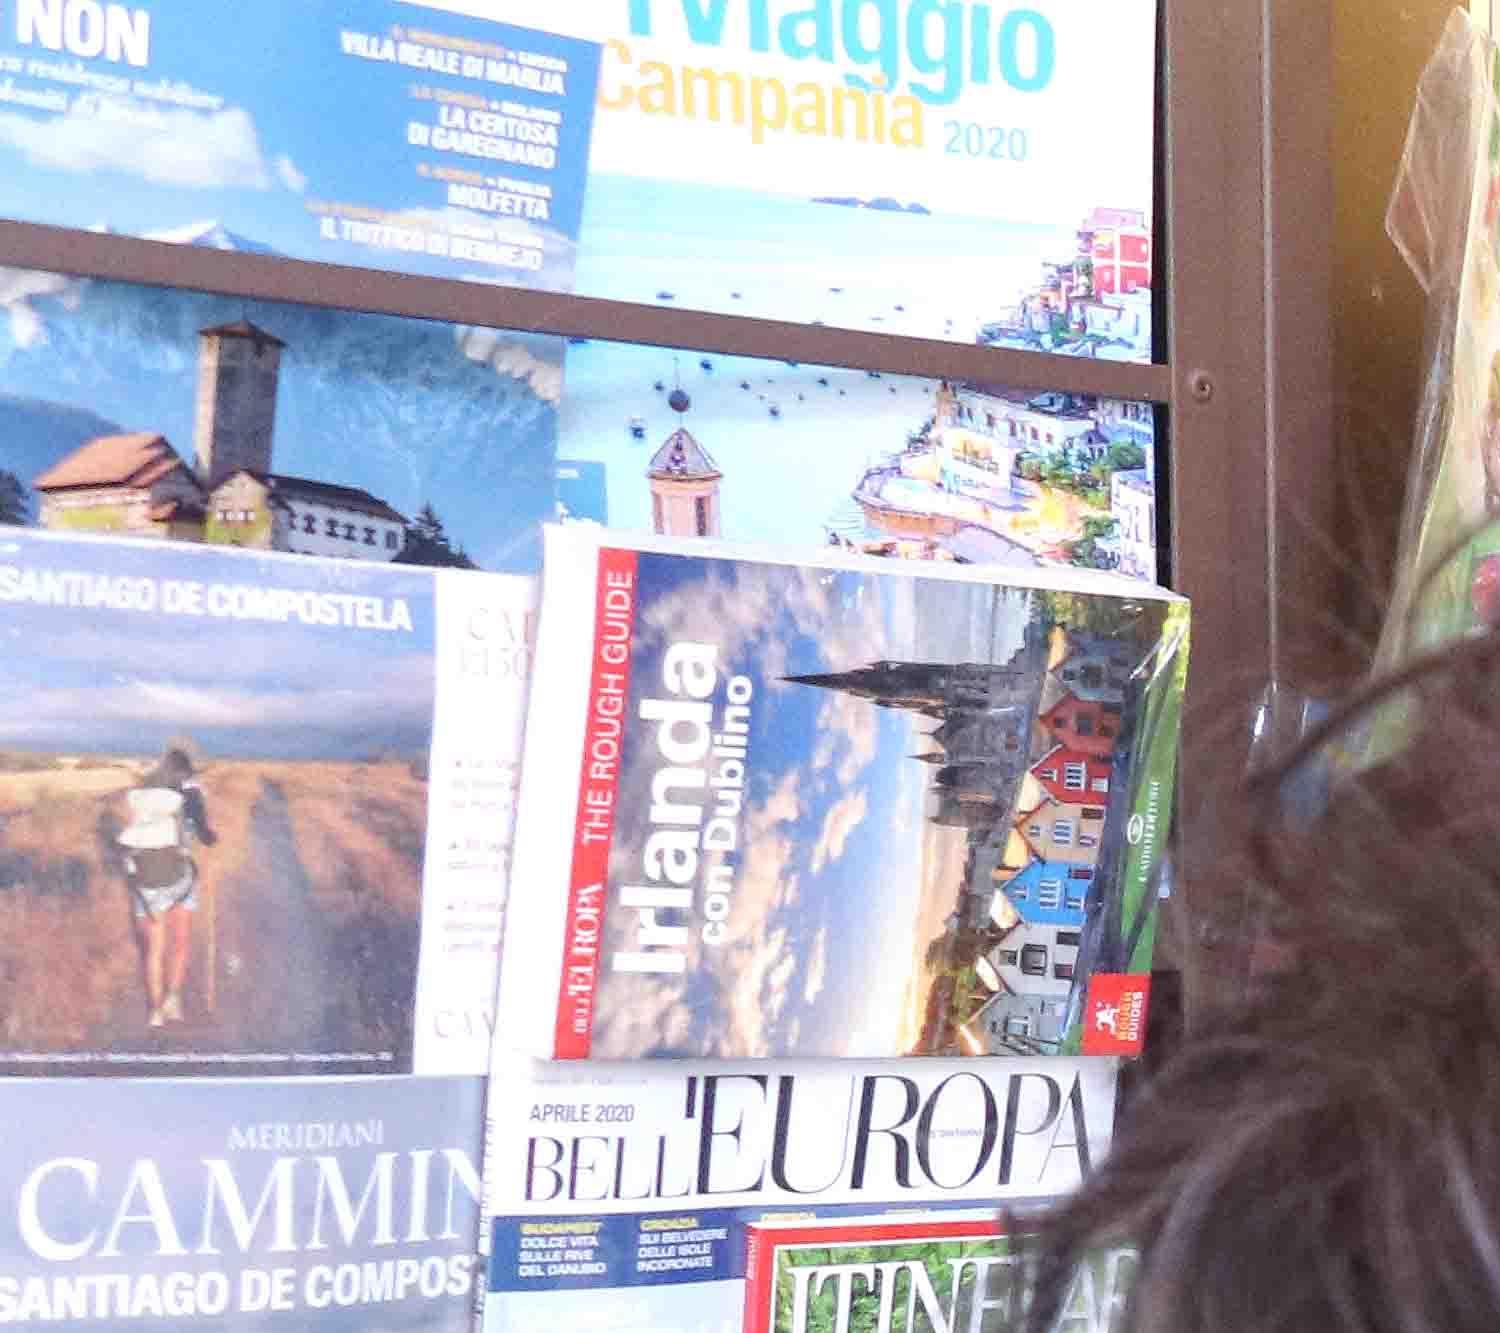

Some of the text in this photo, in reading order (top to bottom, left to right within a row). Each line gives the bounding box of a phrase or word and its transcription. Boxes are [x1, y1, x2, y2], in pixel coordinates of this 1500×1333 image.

[16, 0, 149, 68] NON
[600, 38, 924, 149] Campania
[944, 120, 1027, 162] 2020
[210, 581, 412, 633] COMPOSTELA
[591, 570, 634, 794] ROUGH GUIDE
[705, 674, 753, 852] Dublino
[613, 640, 718, 974] Irlanda
[228, 1119, 384, 1150] MERIDIANI
[529, 1102, 635, 1124] APRILE 2020
[0, 1268, 294, 1322] SANTIAGO DE
